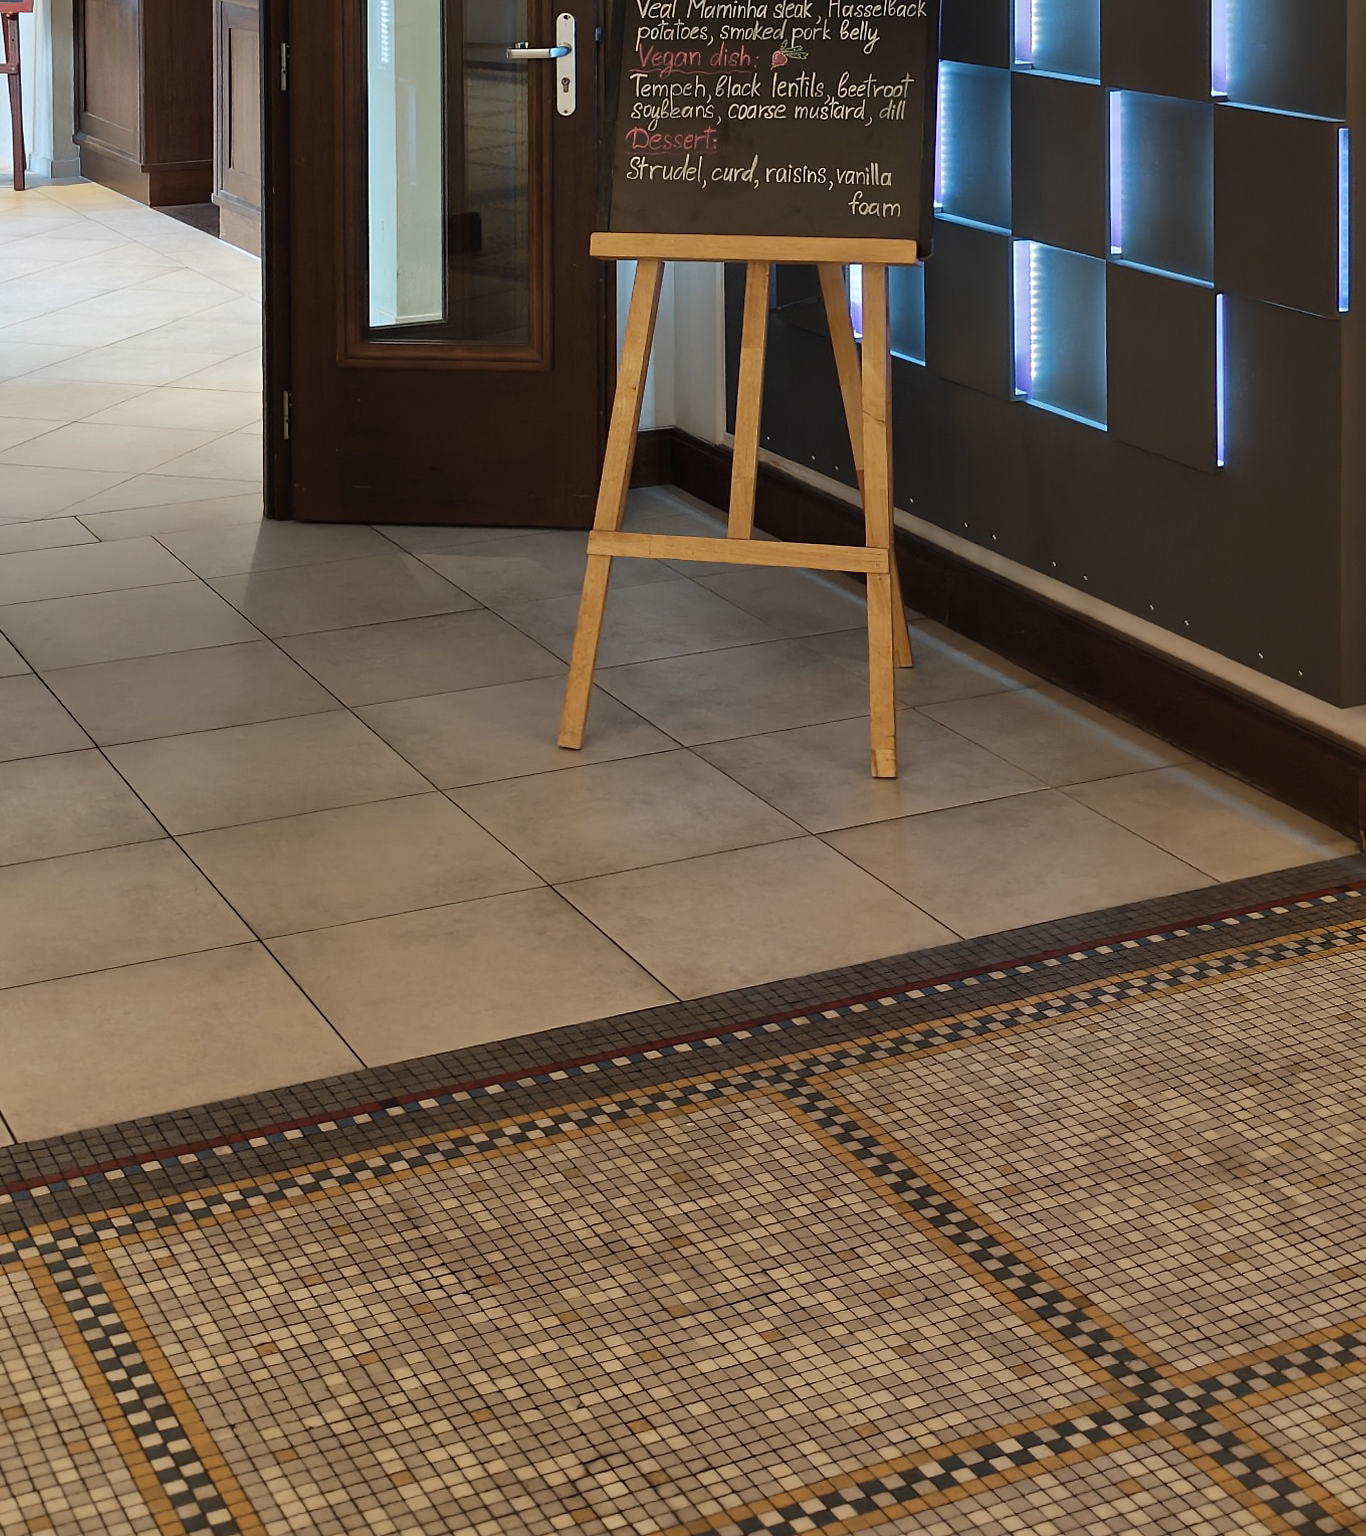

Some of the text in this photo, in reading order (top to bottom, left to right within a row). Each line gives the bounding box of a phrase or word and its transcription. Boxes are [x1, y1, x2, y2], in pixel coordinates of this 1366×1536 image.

[635, 18, 715, 52] potatoes,
[791, 20, 832, 49] pork
[839, 19, 881, 55] belly
[638, 41, 760, 78] Vegan dish:
[629, 74, 713, 109] Tempeh,
[714, 75, 762, 99] black
[837, 70, 915, 100] beetroot
[630, 98, 906, 132] soybeans, coarse mustard, dill
[625, 125, 719, 151] Dessert:
[625, 153, 893, 190] Strudel, curd, raisins, vanilla
[848, 191, 902, 217] foam
